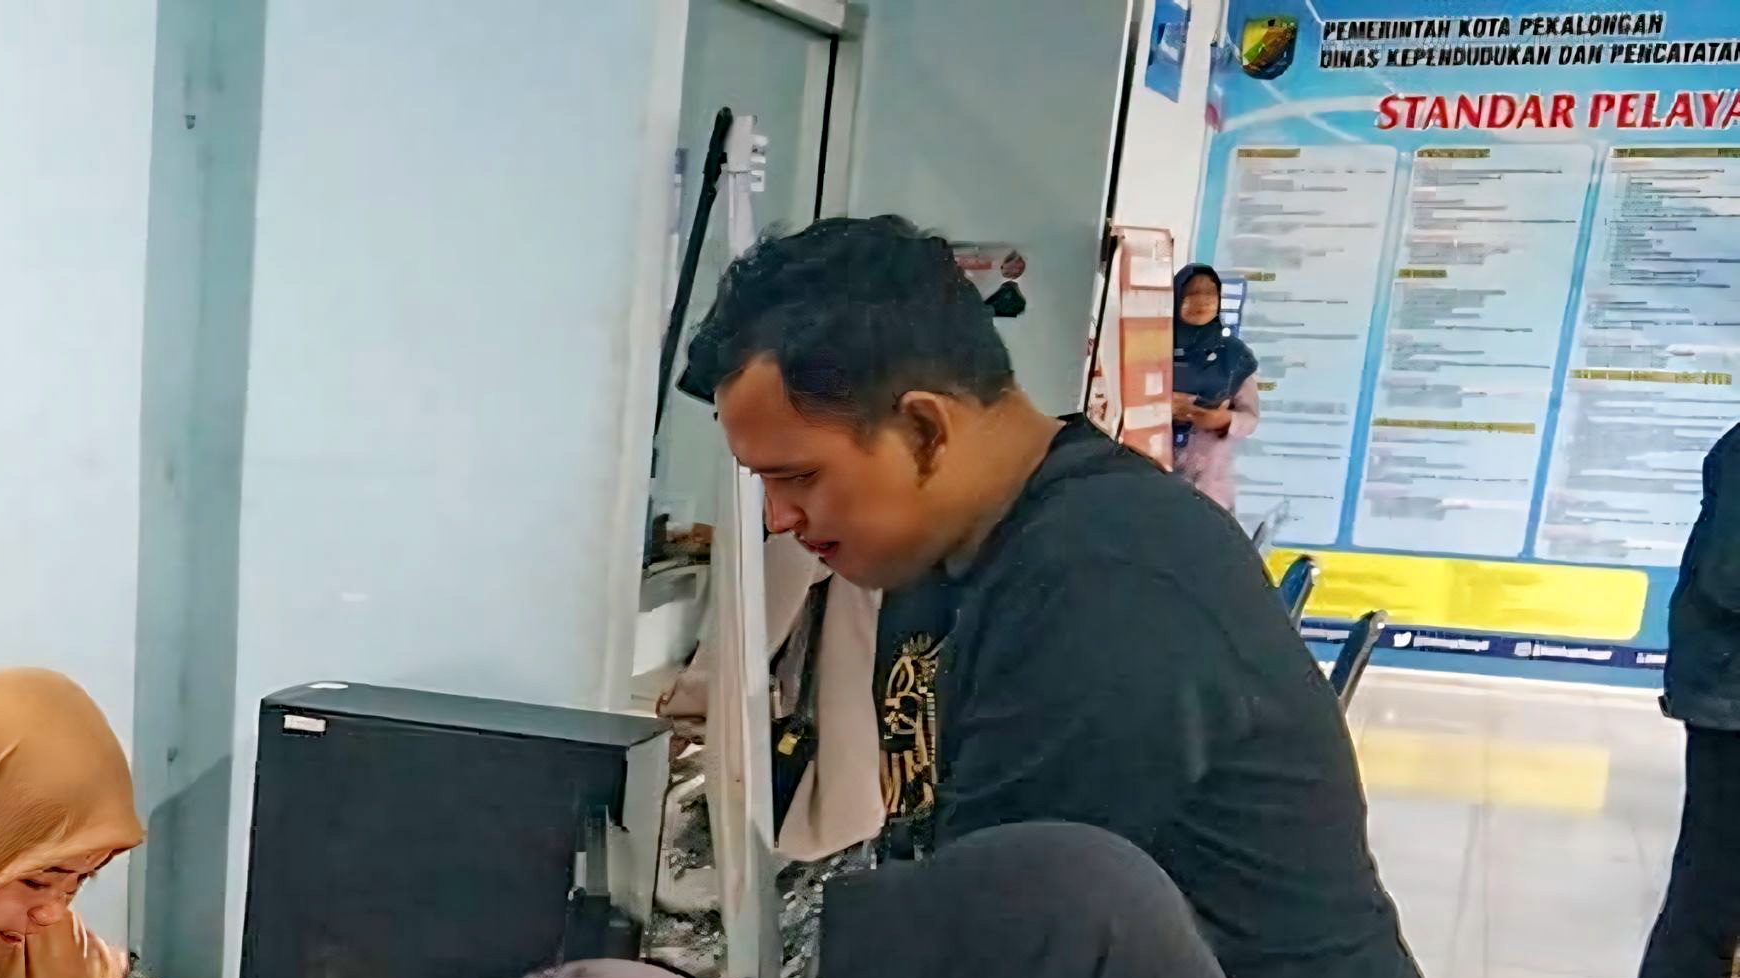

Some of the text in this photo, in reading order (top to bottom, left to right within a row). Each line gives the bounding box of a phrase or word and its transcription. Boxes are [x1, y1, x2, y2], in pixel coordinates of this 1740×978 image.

[1323, 13, 1664, 41] PEMERINTAH KOTA PEKALONGAN
[1320, 47, 1381, 68] DINAS
[1386, 44, 1552, 67] KEPENDUDUKAN
[1558, 43, 1604, 66] DAN
[1377, 94, 1575, 130] STANDAR
